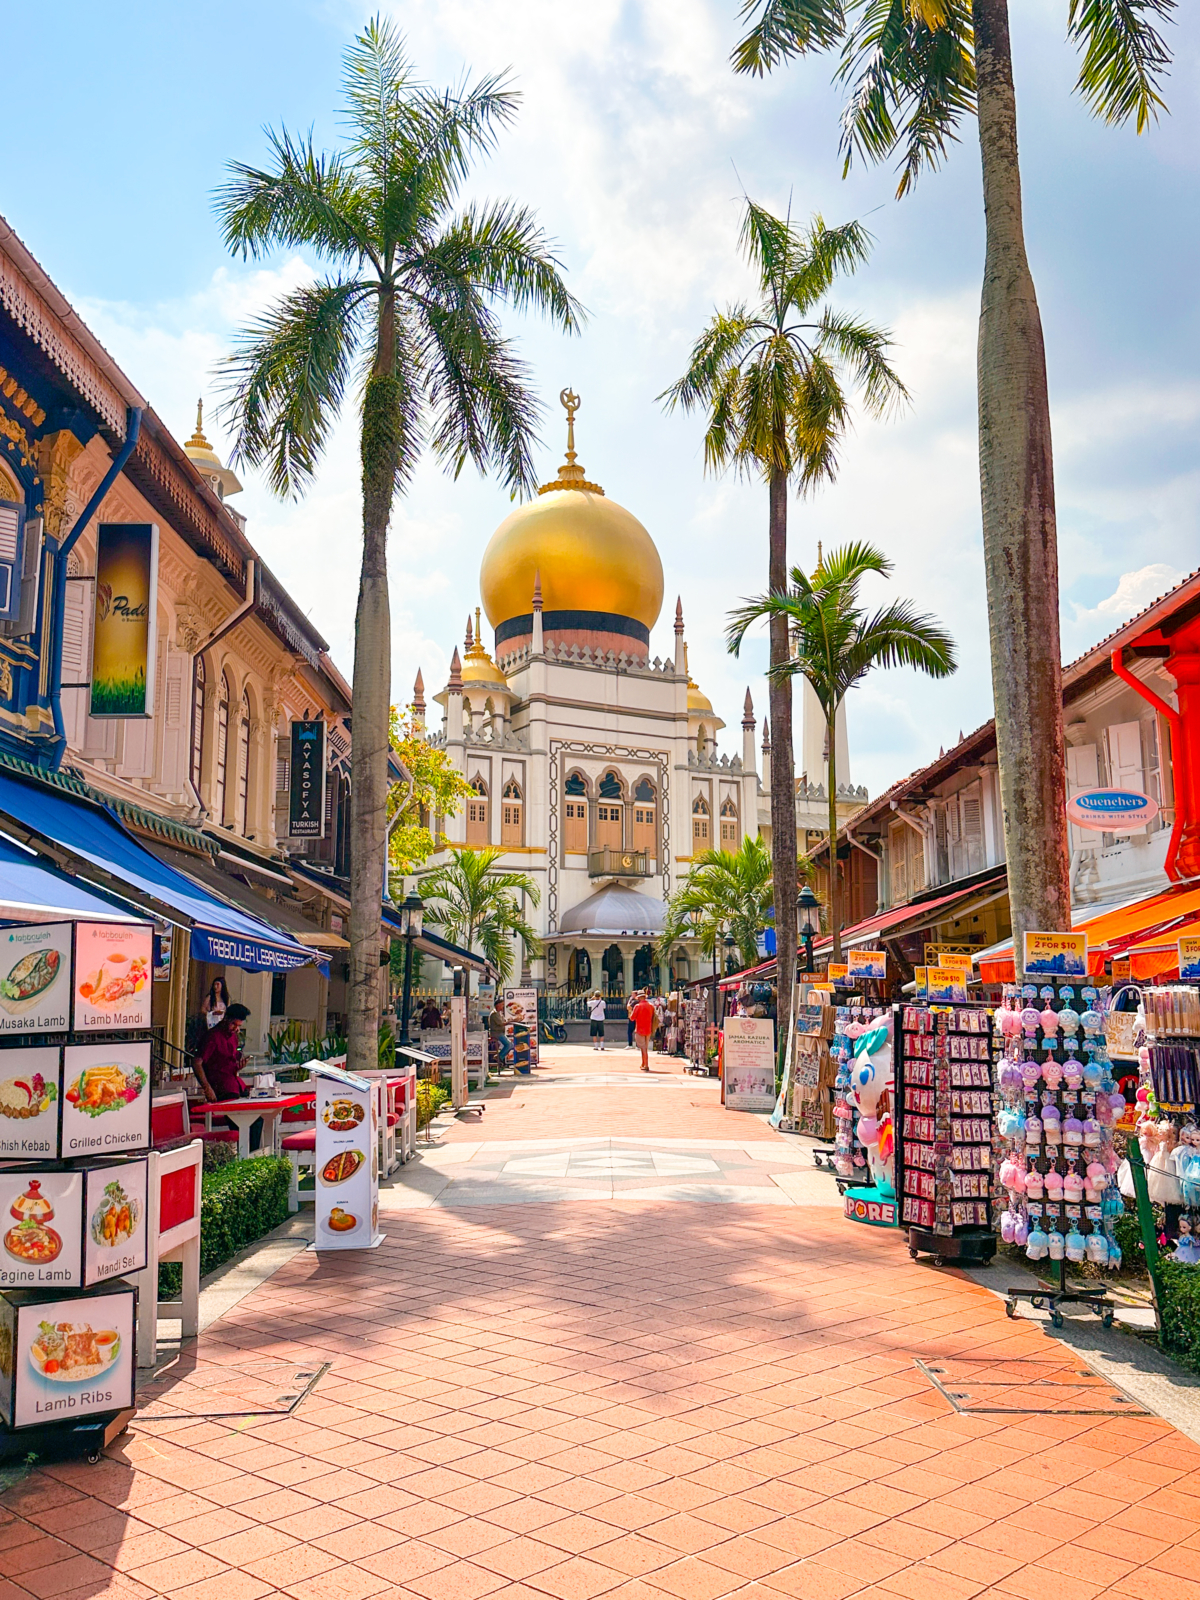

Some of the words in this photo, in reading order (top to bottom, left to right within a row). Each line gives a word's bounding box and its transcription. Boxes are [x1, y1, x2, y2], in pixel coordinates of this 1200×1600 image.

[113, 596, 148, 616] Padi
[301, 742, 311, 818] AYASOFYA
[1080, 796, 1143, 808] Quenchers
[208, 936, 255, 962] TABBOULEH
[1061, 941, 1076, 949] $10
[38, 1015, 66, 1027] Lamb
[84, 1014, 111, 1025] Lamb
[114, 1013, 143, 1024] Mandi
[0, 1140, 19, 1151] hish
[21, 1140, 50, 1151] Kebab
[69, 1136, 101, 1149] Grilled
[104, 1132, 142, 1145] Chicken
[97, 1259, 121, 1277] Mandi
[122, 1255, 136, 1269] Set
[38, 1268, 72, 1281] Lamb
[36, 1395, 76, 1413] Lamb
[80, 1391, 113, 1406] Ribs
